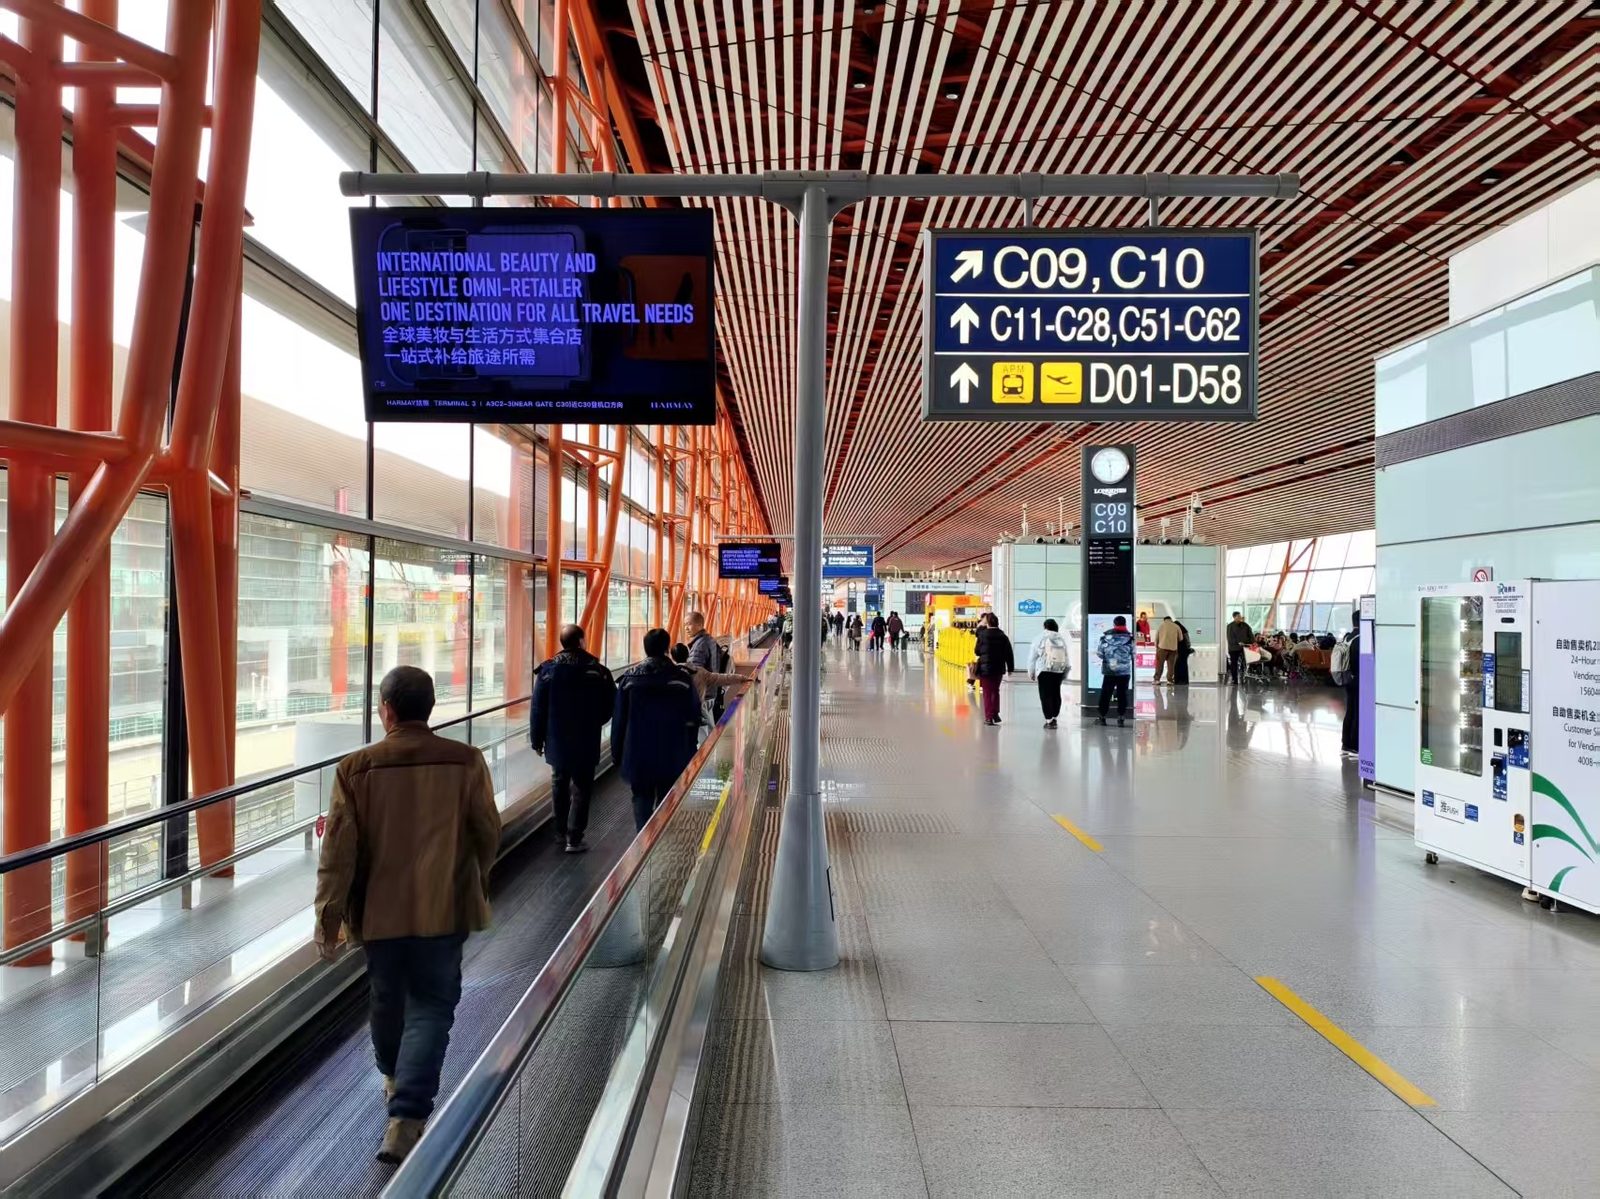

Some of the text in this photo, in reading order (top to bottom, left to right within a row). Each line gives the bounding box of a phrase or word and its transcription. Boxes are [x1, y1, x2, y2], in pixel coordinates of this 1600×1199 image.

[376, 251, 596, 274] INTERNATIONAL BEAUTY AND
[378, 276, 582, 299] LIFESTYLE OMNI-RETAILER
[380, 301, 694, 324] ONE DESTINATION FOR ALL TRAVEL NEEDS
[382, 326, 583, 346] 全球美妆与生活方式集合店
[384, 347, 536, 367] 一站式补给旅途所需
[1002, 364, 1025, 373] APM
[1089, 362, 1242, 405] D01-D58
[433, 399, 470, 408] TERMINAL
[650, 401, 694, 409] HARMAY
[1094, 502, 1127, 517] C09
[1094, 520, 1127, 533] C10
[1563, 722, 1592, 736] Customer
[1568, 738, 1577, 748] for
